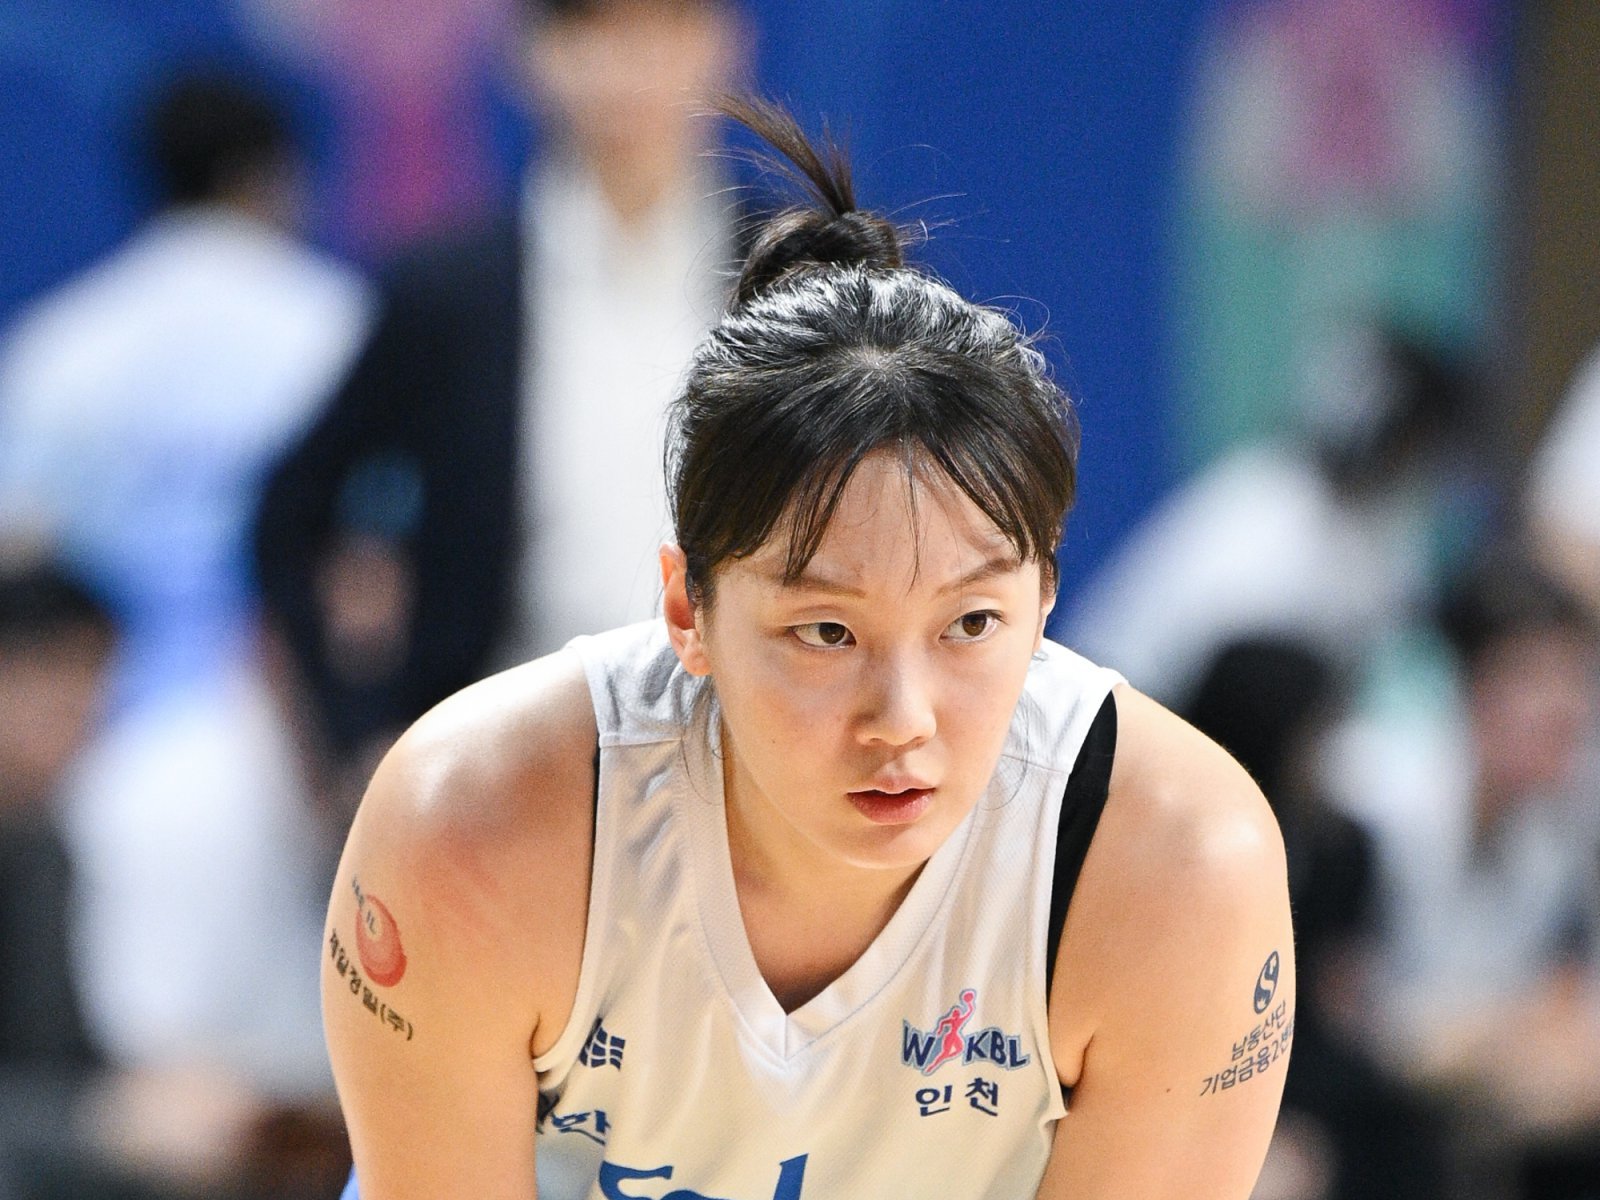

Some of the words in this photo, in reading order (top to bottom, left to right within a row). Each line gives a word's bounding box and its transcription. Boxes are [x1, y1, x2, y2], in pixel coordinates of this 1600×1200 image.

[903, 1019, 1029, 1070] WKBL
[1231, 1000, 1286, 1062] 남동산단
[915, 1077, 998, 1117] 인천
